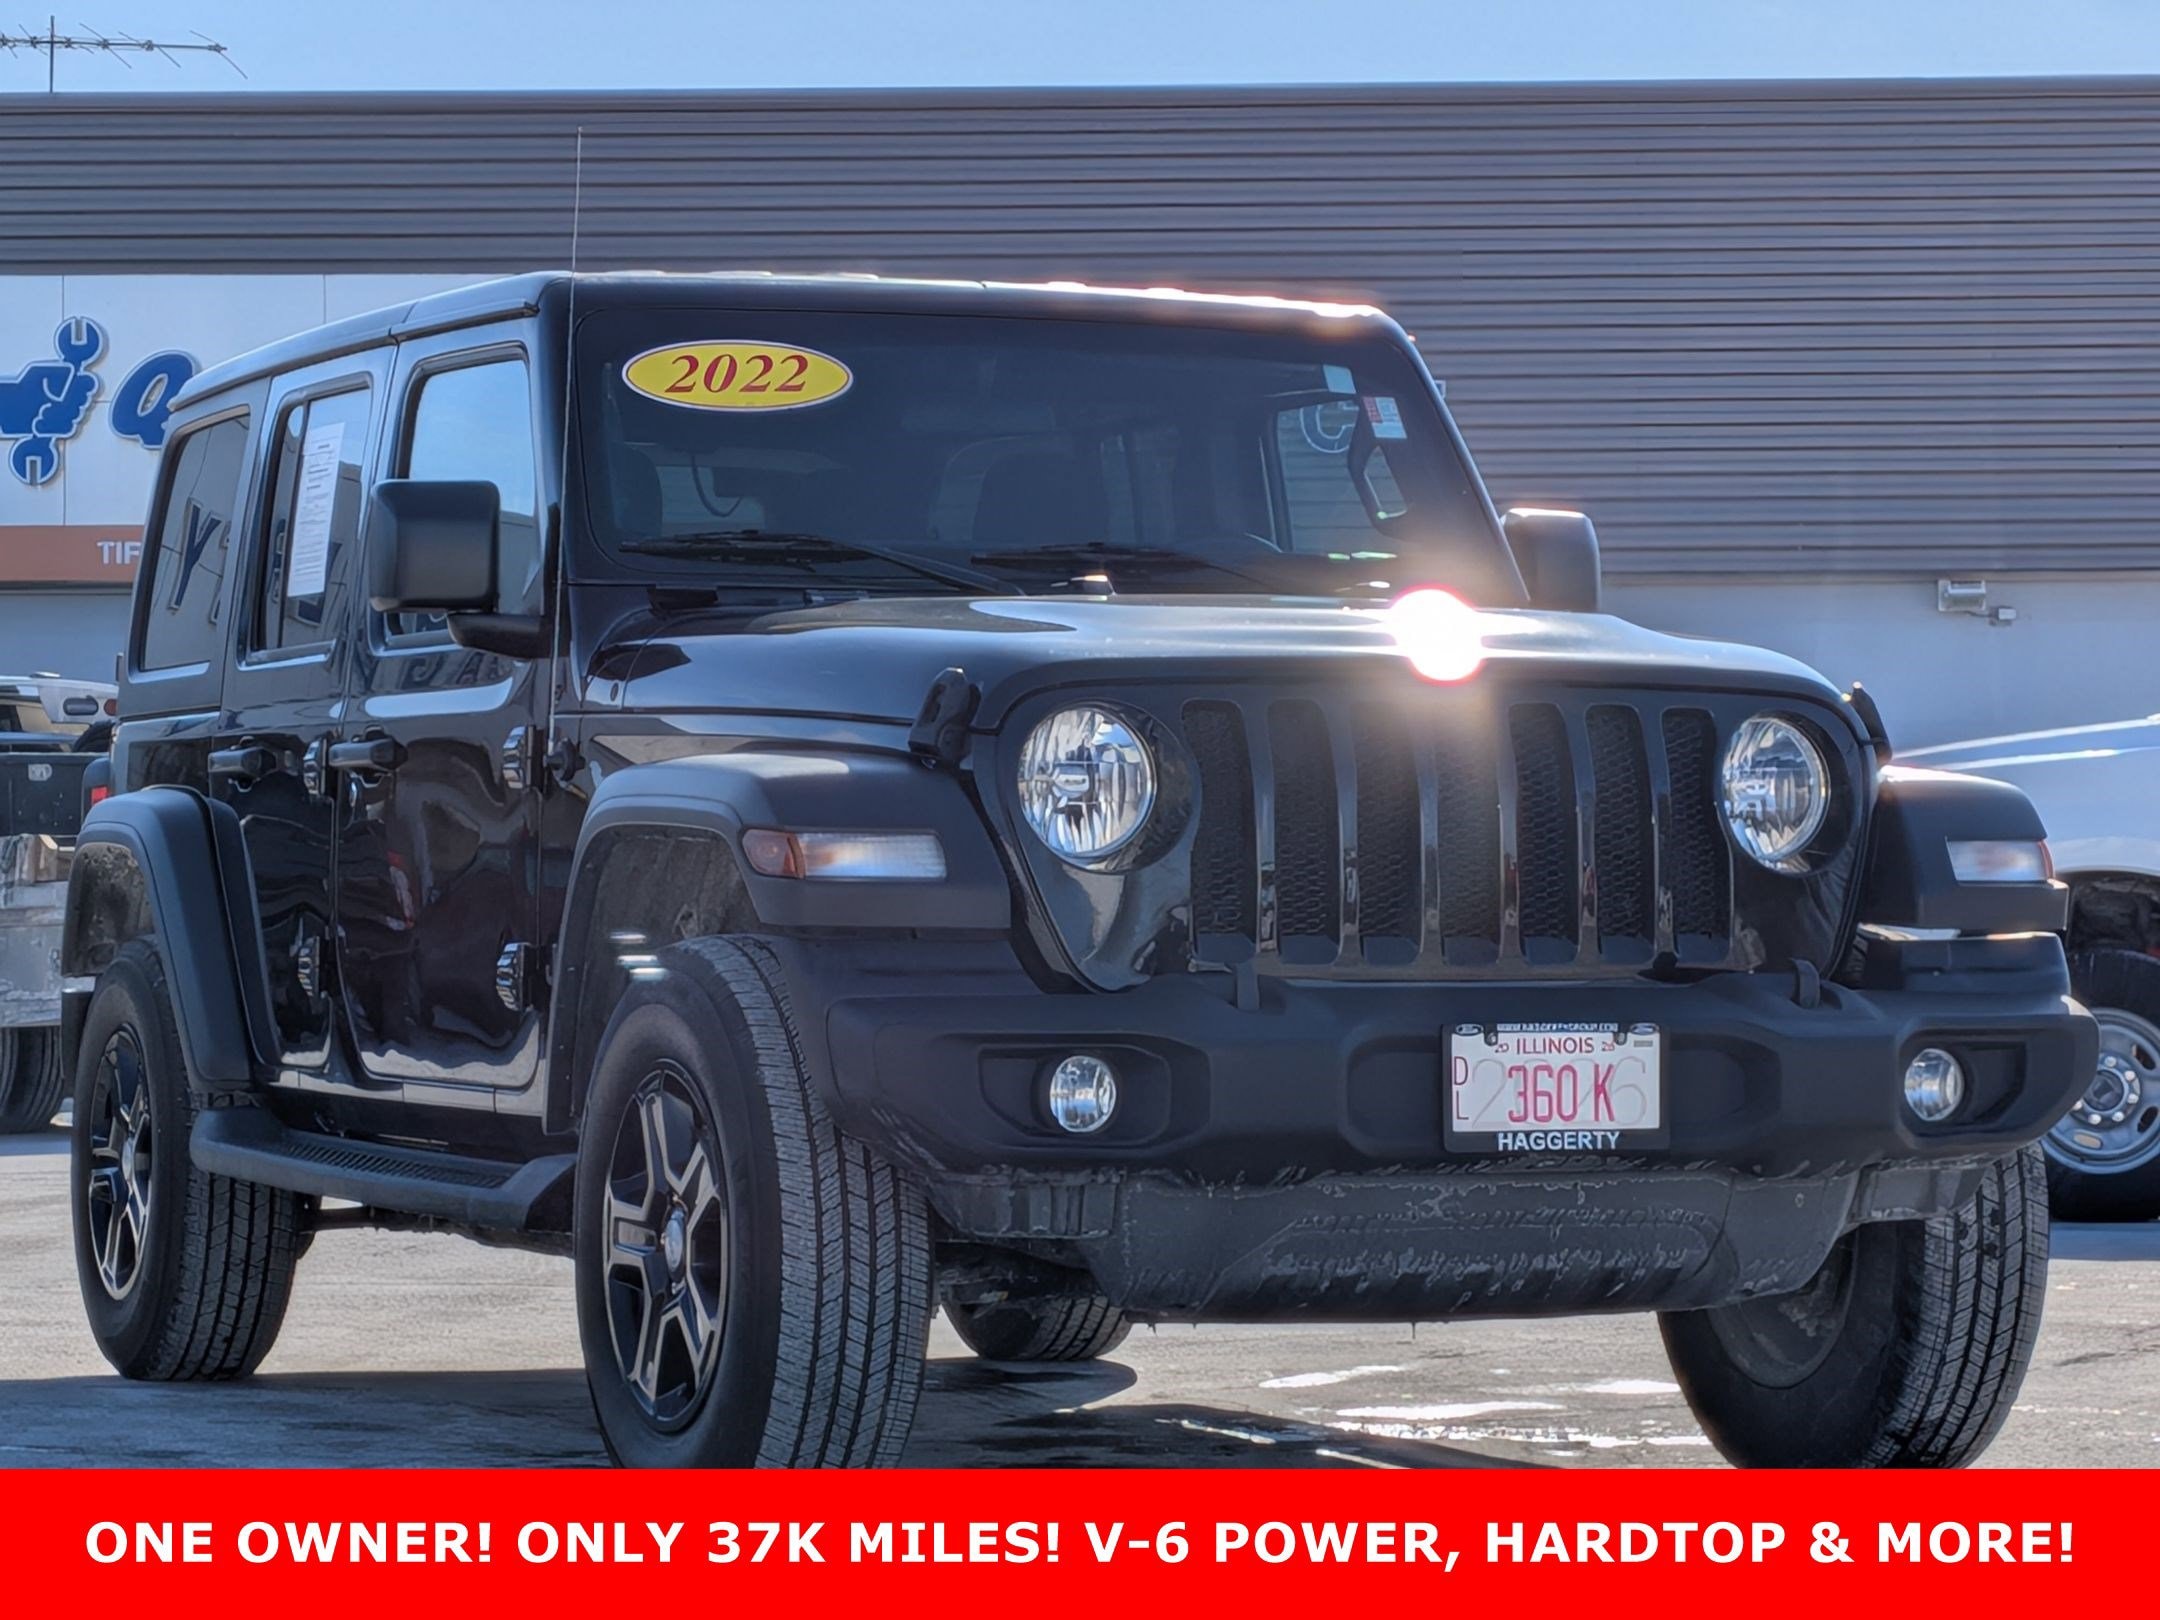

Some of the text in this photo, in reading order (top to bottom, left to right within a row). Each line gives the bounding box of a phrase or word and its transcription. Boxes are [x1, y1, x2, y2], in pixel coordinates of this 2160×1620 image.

[664, 353, 808, 393] 2022
[1516, 1036, 1595, 1055] ILLINOIS
[1507, 1063, 1616, 1123] 360 K
[1498, 1130, 1620, 1151] HAGGERTY
